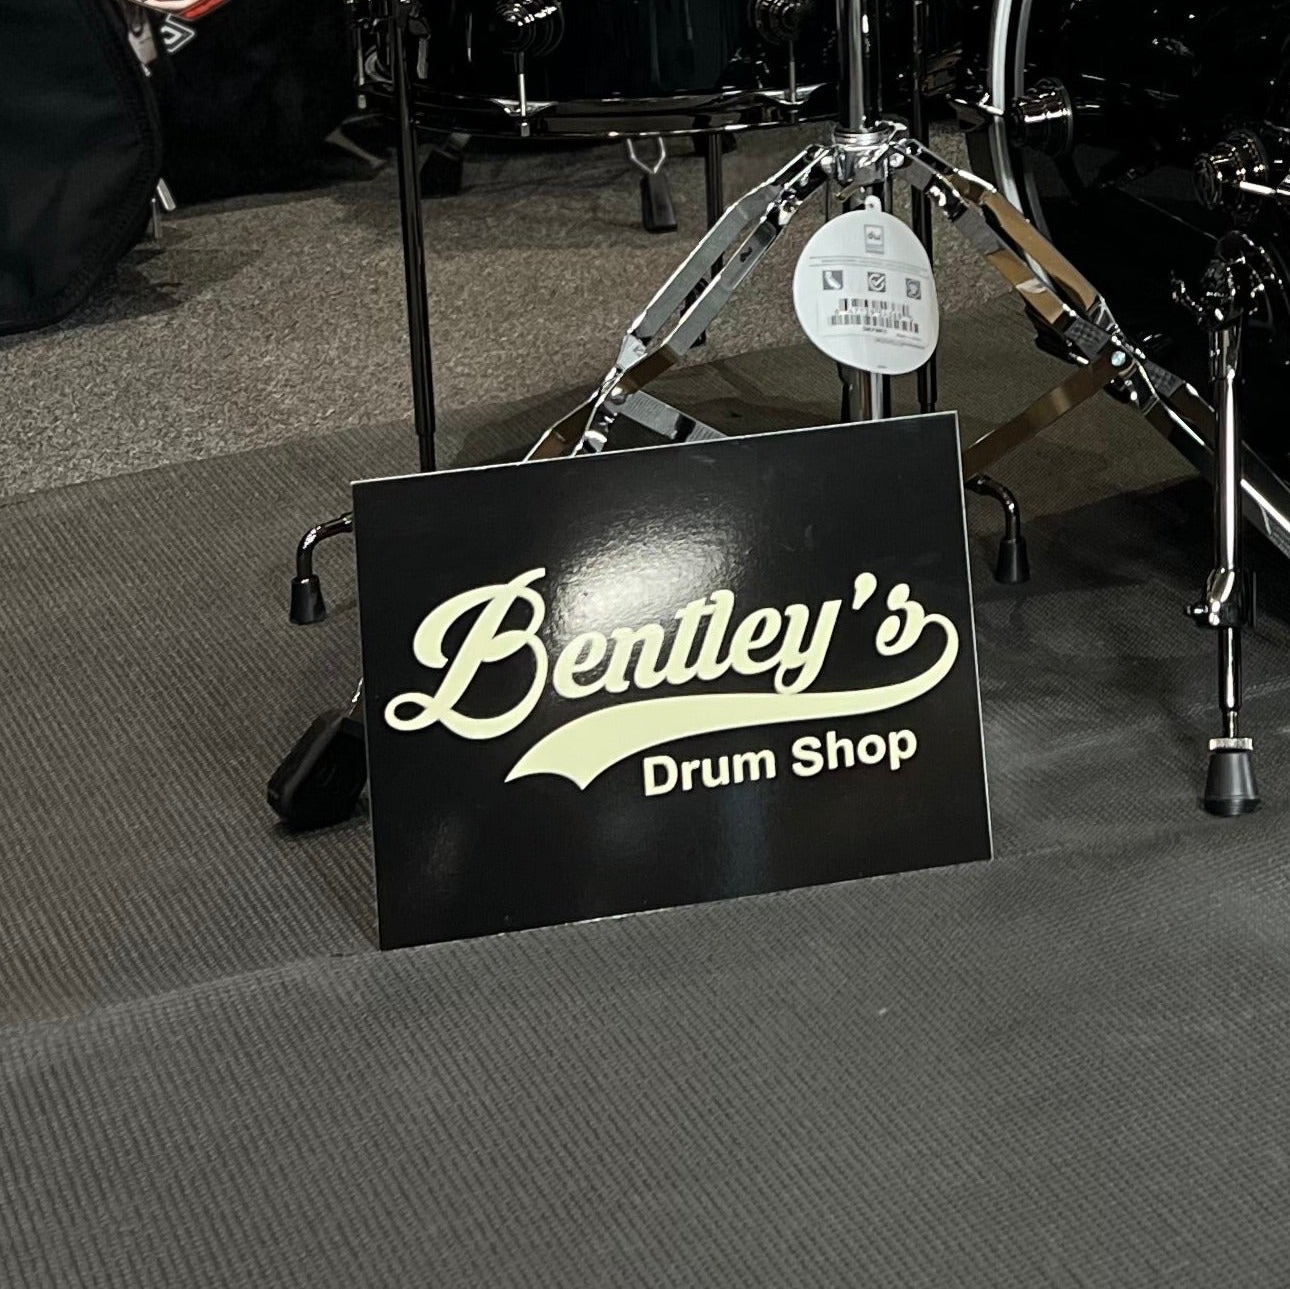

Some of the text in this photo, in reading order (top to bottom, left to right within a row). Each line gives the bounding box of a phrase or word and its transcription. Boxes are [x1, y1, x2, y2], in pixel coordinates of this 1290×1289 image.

[384, 567, 924, 740] Bentley's
[642, 727, 919, 797] Drum Shop
